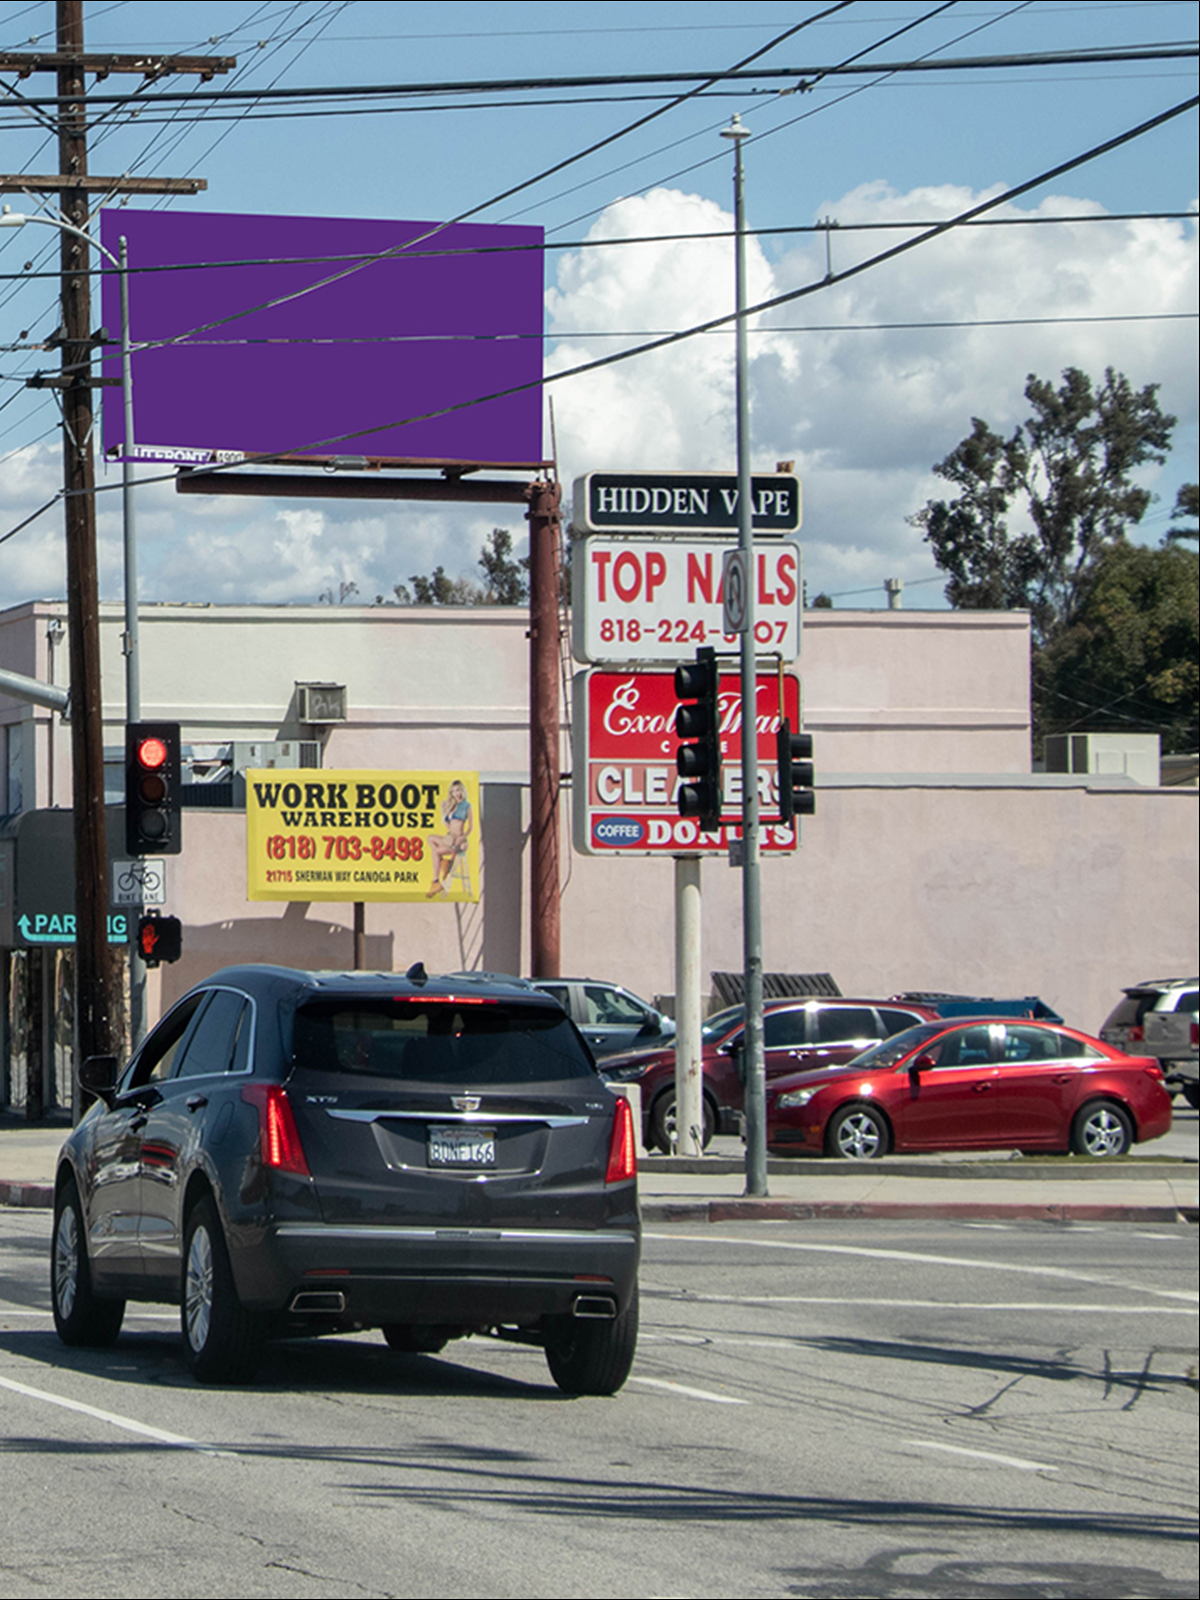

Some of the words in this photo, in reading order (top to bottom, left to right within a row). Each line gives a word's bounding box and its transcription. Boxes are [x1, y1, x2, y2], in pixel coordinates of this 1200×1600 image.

[597, 487, 710, 515] HIDDEN
[591, 550, 667, 603] TOP
[687, 552, 797, 606] NLS
[600, 618, 788, 644] 818-224-07
[603, 677, 684, 736] Exot
[660, 740, 728, 753] CE
[253, 783, 349, 809] WORK
[355, 784, 440, 810] BOOT
[597, 766, 781, 805] CLEAER
[280, 811, 435, 828] WAREHOUSE
[597, 824, 640, 838] COFFEE
[266, 835, 316, 860] (818)
[322, 836, 424, 861] 703-8498
[266, 870, 293, 883] 21715
[295, 871, 333, 883] SHERMAN
[335, 871, 351, 883] WAY
[353, 871, 392, 884] CANOGA
[394, 872, 419, 884] PARK
[35, 914, 127, 933] PARG
